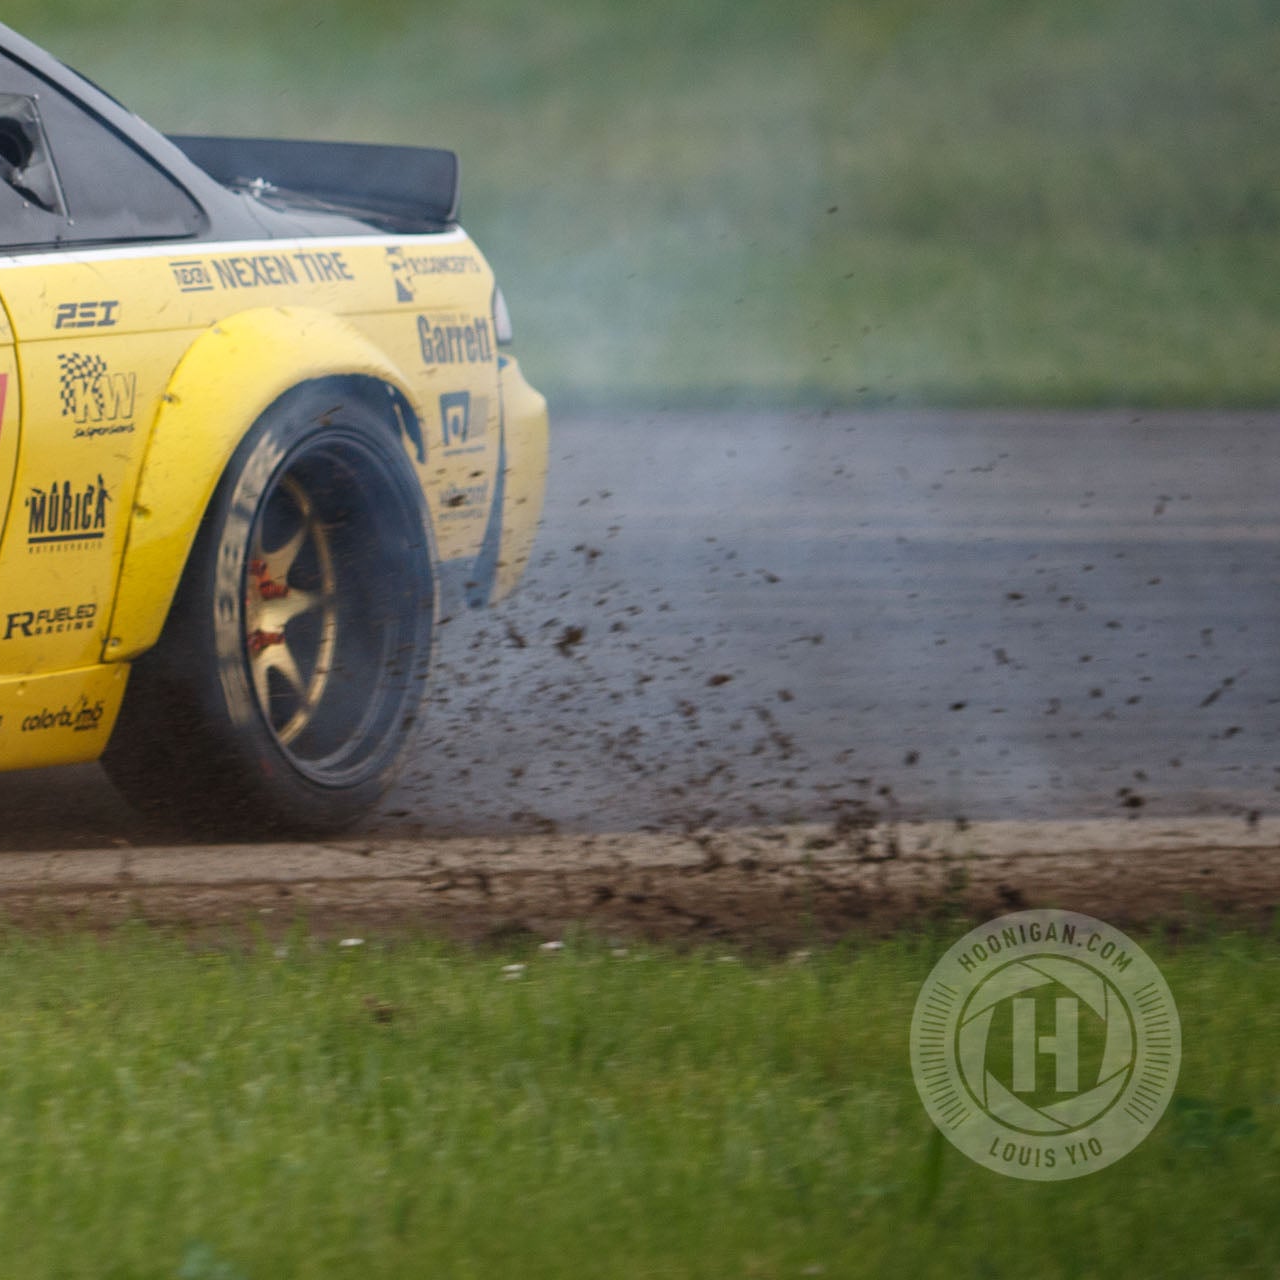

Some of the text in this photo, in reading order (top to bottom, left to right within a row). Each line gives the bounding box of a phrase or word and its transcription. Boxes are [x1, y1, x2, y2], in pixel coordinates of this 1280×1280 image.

[211, 254, 299, 290] NEXEN
[293, 251, 355, 283] TIRE
[416, 314, 494, 365] Garrett
[73, 372, 137, 423] KW
[36, 603, 98, 624] FUELED
